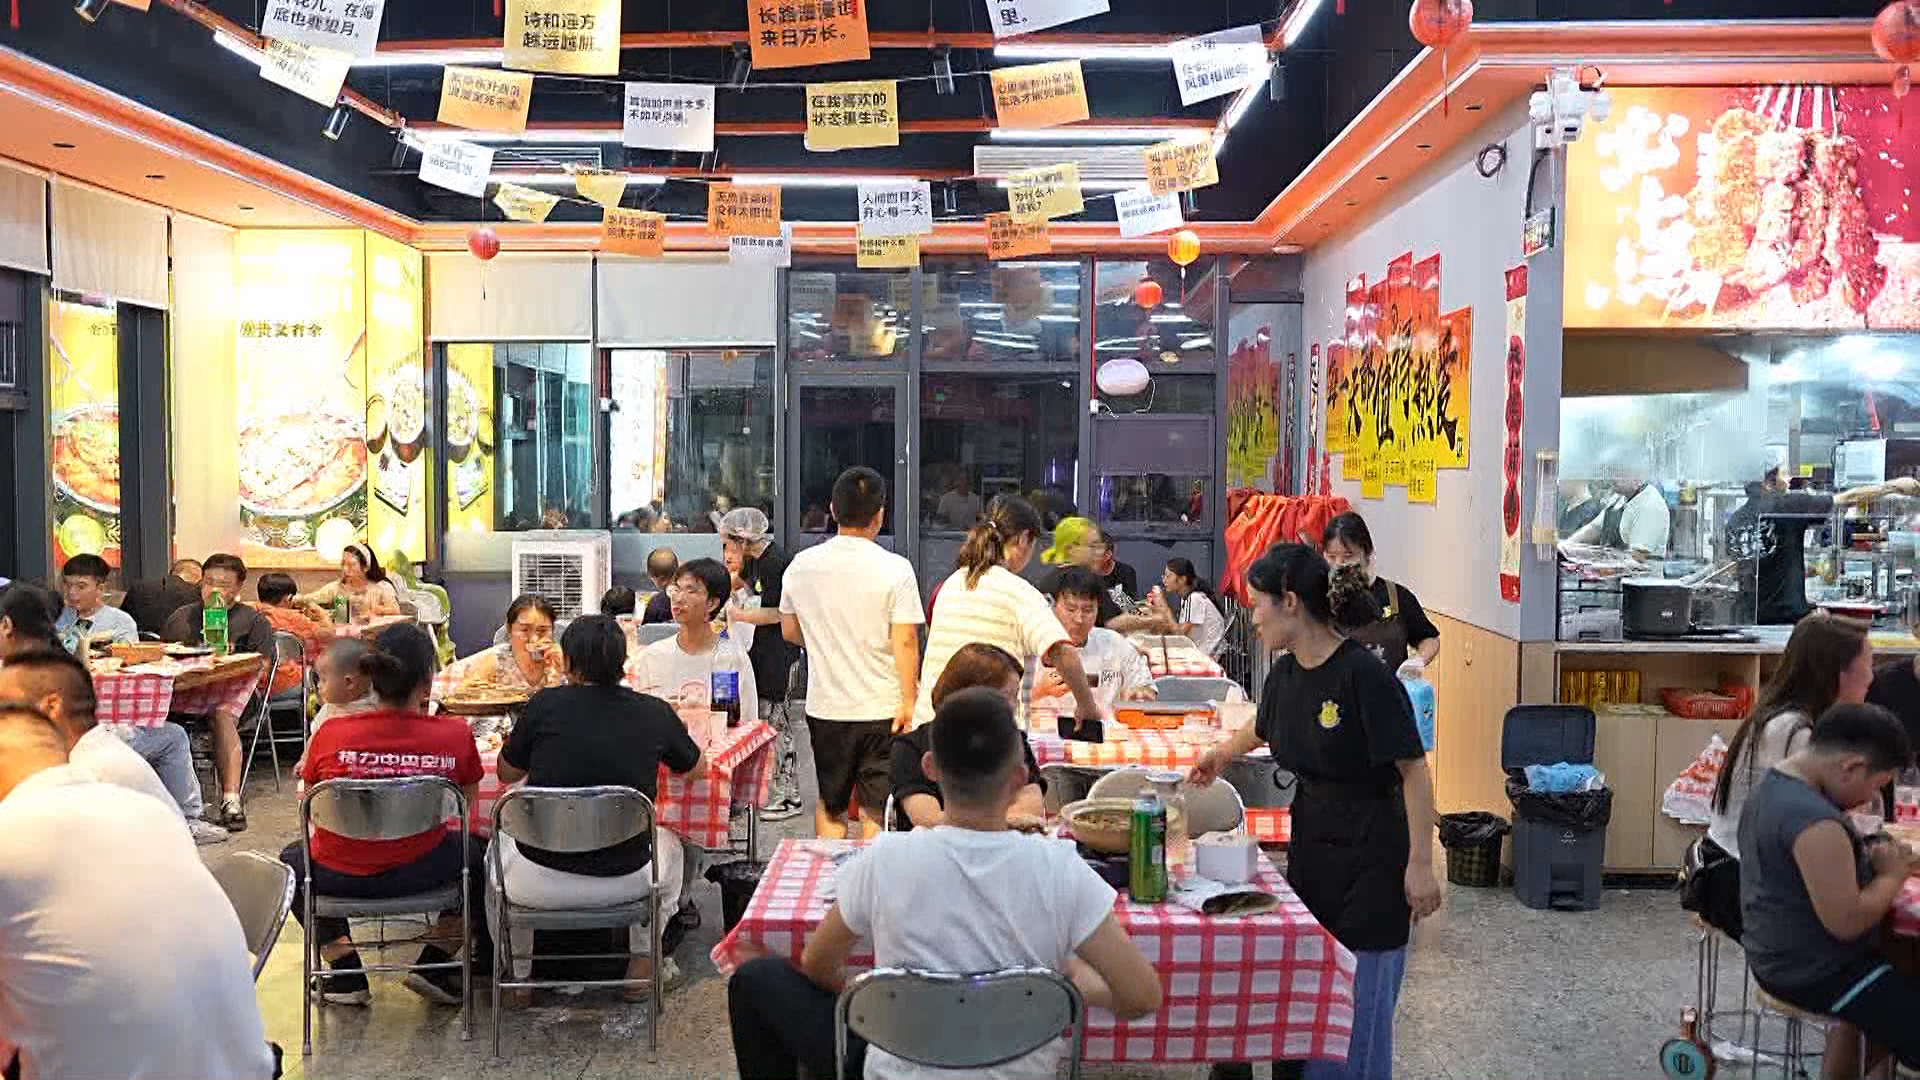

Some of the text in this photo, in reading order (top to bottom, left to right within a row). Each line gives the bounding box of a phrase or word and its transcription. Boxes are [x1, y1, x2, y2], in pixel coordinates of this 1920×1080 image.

[524, 10, 595, 29] 诗和远方
[1000, 8, 1028, 26] 里。
[760, 24, 846, 46] 来日方长。
[812, 93, 887, 108] 在我喜欢的
[337, 750, 456, 769] 格力中央空调
